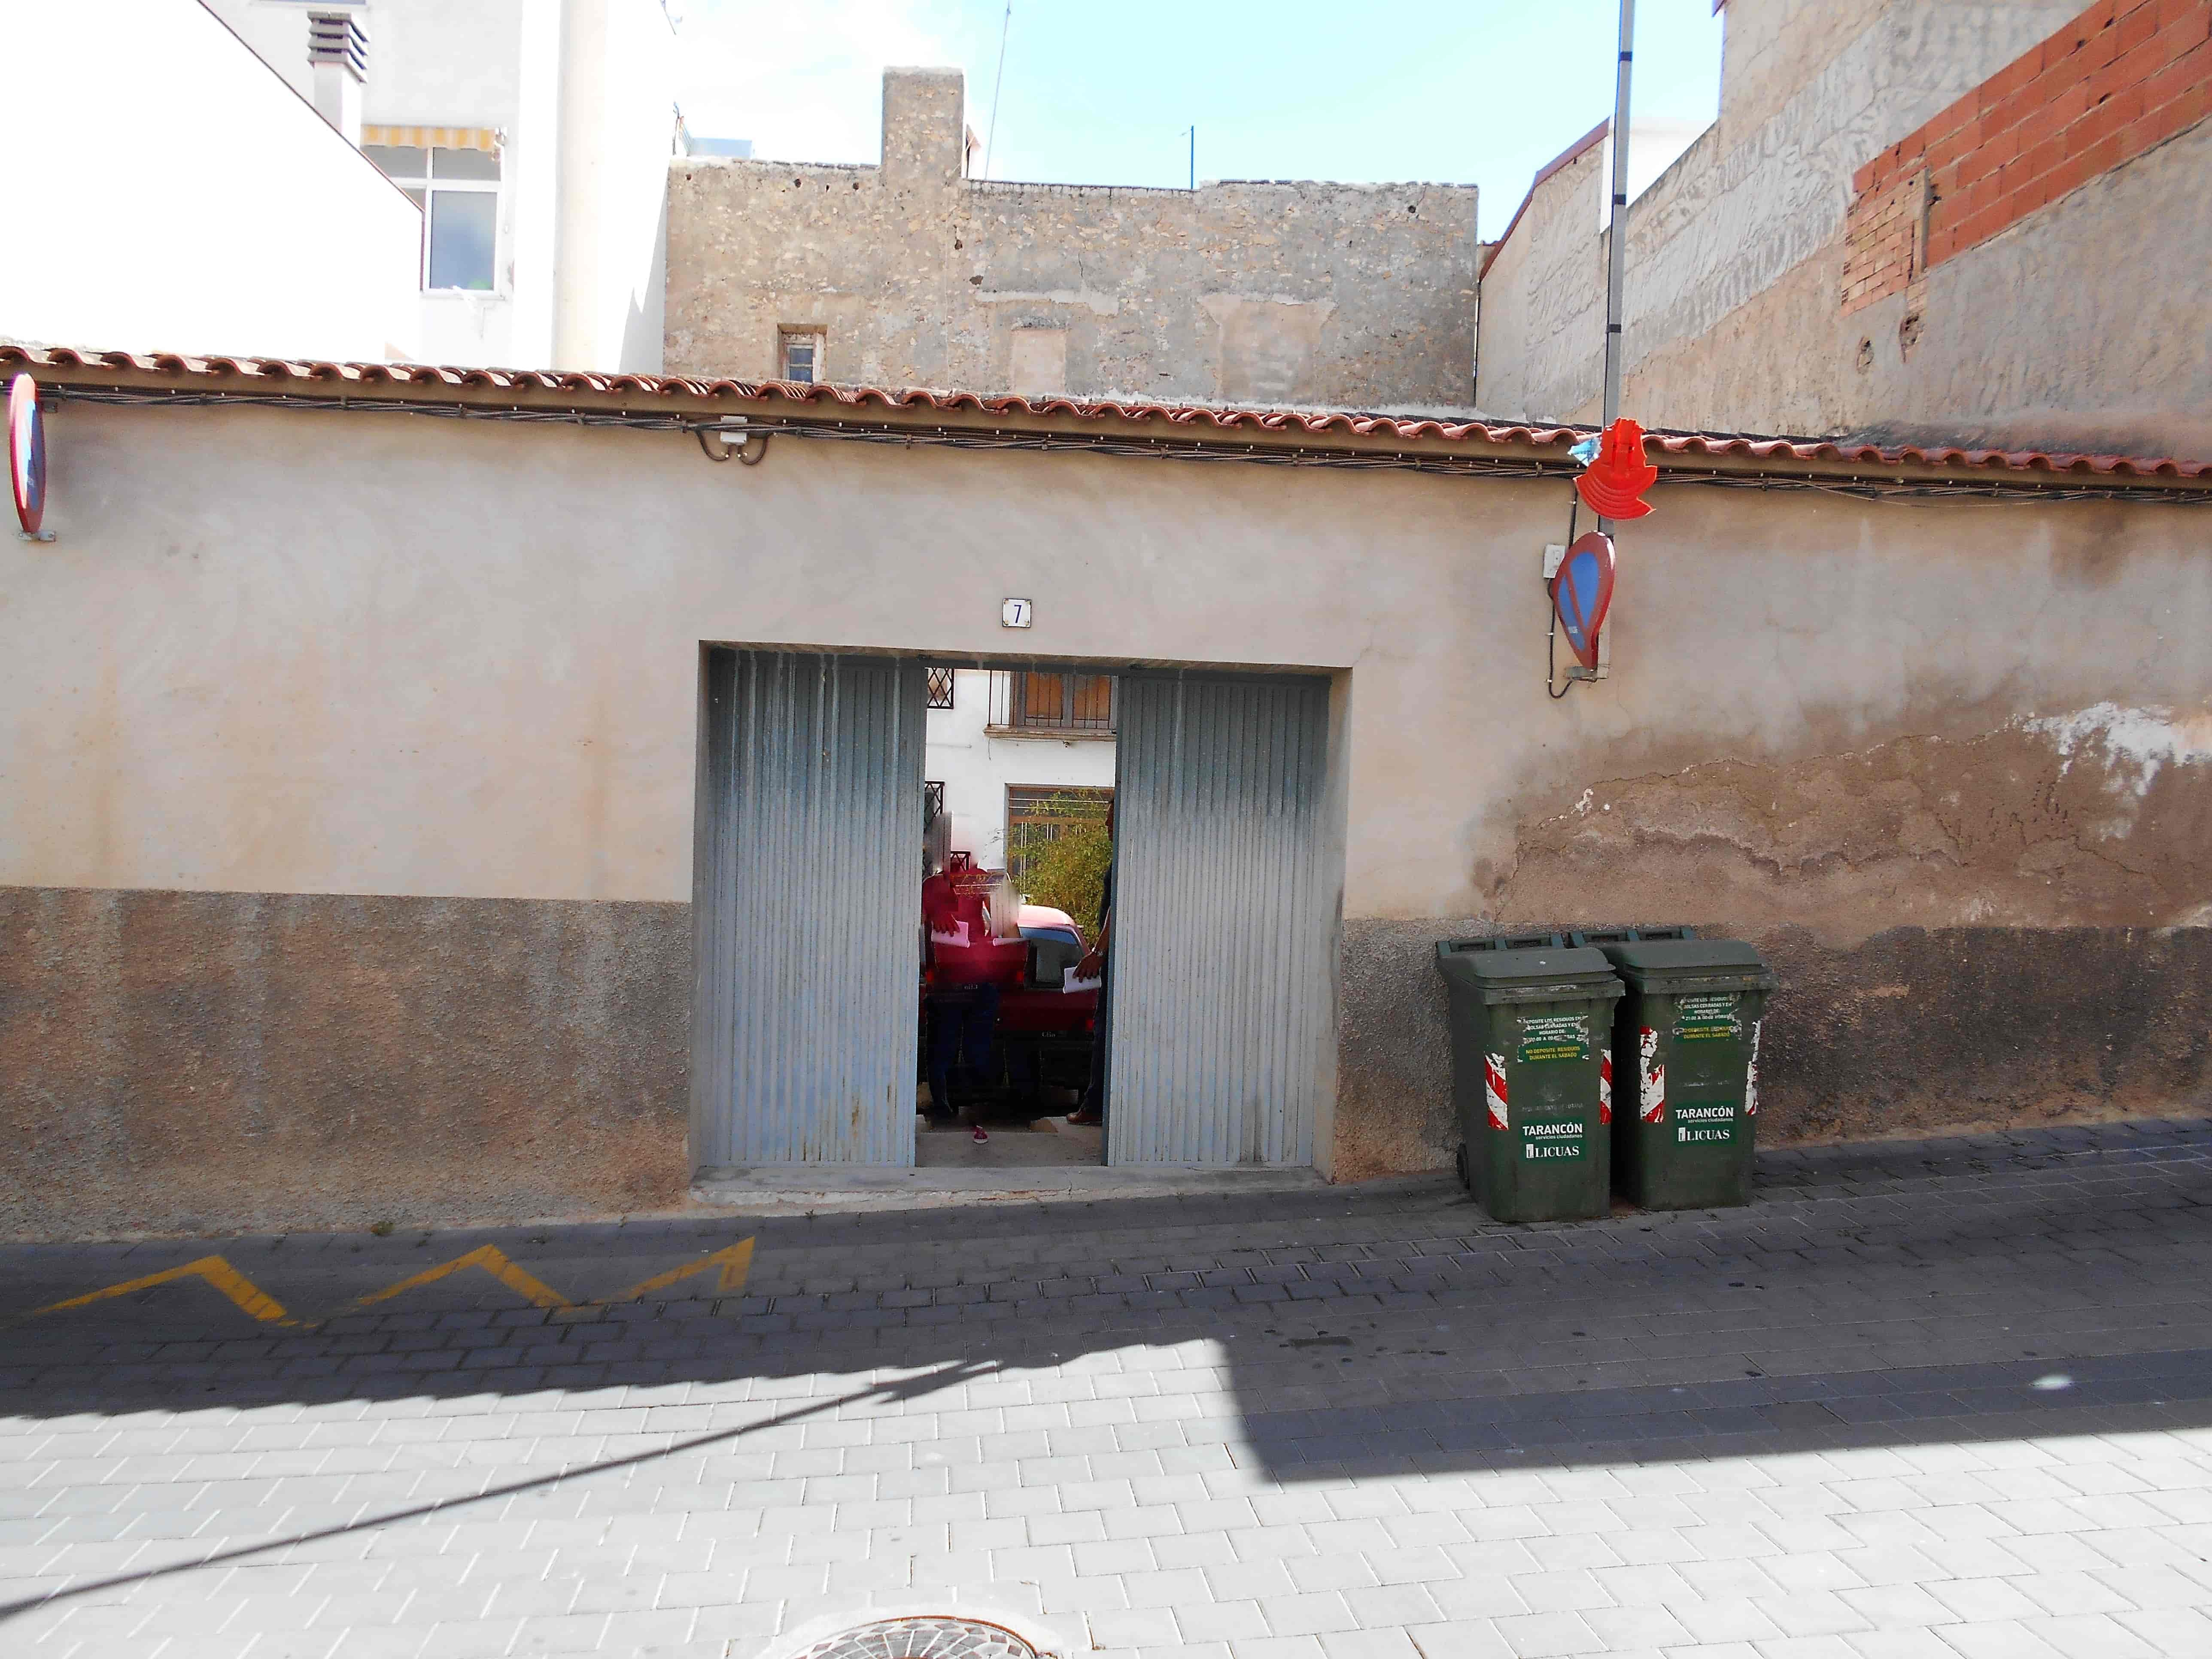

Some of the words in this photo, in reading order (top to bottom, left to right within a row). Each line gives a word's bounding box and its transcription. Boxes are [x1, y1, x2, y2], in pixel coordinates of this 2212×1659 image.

[1014, 605, 1022, 623] 7
[1675, 1106, 1734, 1119] TARANCÓN
[1522, 1122, 1583, 1136] TARANCÓN
[1687, 1129, 1730, 1141] LICUAS
[1535, 1146, 1579, 1157] LICUAS
